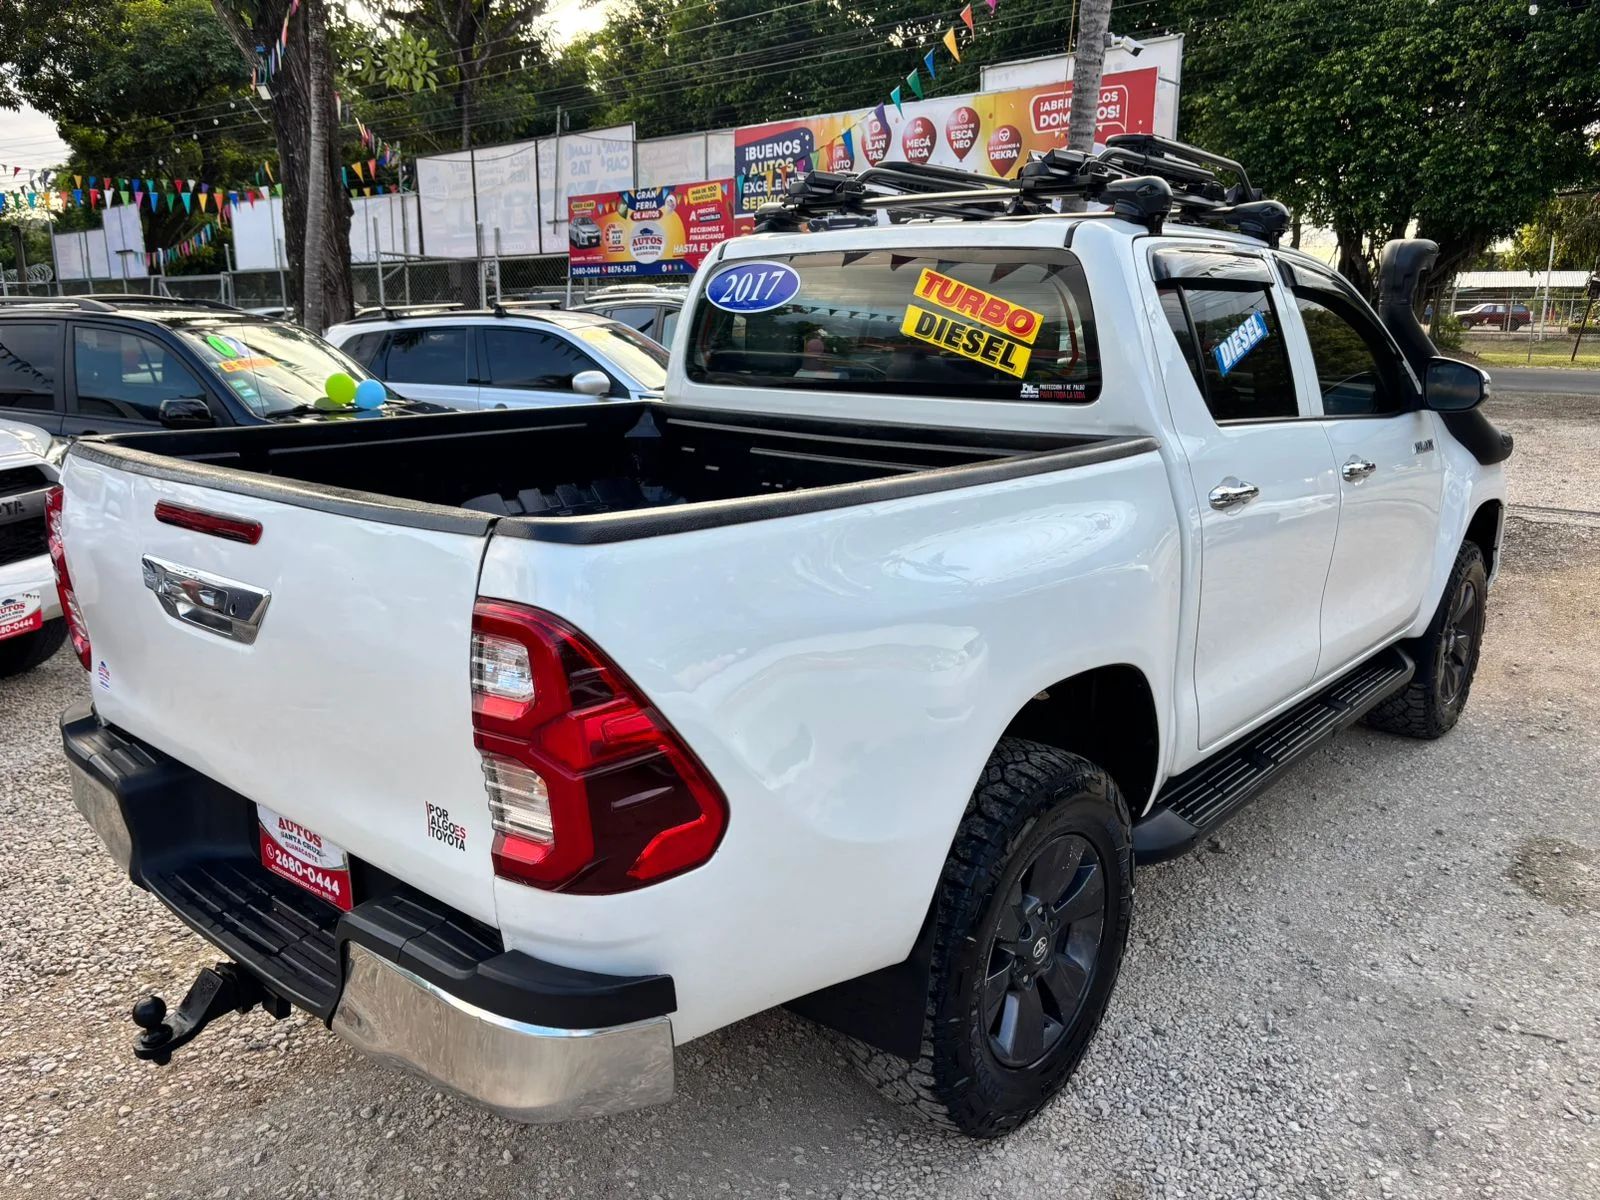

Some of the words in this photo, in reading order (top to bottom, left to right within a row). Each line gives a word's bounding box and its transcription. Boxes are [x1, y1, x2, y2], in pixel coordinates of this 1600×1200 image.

[1040, 98, 1073, 113] ¡ABRI
[1097, 91, 1119, 104] LOS
[1040, 104, 1120, 128] DOMOS!
[950, 129, 973, 140] ESCA
[906, 135, 931, 148] MECÁ
[952, 140, 971, 149] NEO
[745, 139, 801, 161] ¡BUENOS
[868, 150, 884, 160] TAS
[908, 148, 929, 158] NICA
[990, 149, 1018, 160] DEKRA
[636, 190, 657, 200] GRAN
[635, 200, 658, 210] FERIA
[689, 210, 697, 221] A
[690, 225, 719, 233] RECIBIMOS
[632, 236, 663, 246] AUTOS
[689, 232, 725, 241] FINANCIAMOS
[673, 243, 698, 254] HASTA
[700, 243, 709, 252] EL
[572, 266, 600, 275] 2680-0444
[718, 270, 787, 303] 2017
[921, 270, 1037, 338] TURBO
[913, 311, 1017, 371] DIESEL
[1218, 313, 1264, 370] DIESEL
[0, 602, 26, 614] UTOS
[0, 617, 34, 634] 80-0444
[428, 803, 449, 821] POR
[278, 816, 323, 848] AUTOS
[281, 831, 302, 846] SANTA
[430, 826, 466, 852] TOYOTA
[275, 849, 340, 896] 2680-0444
